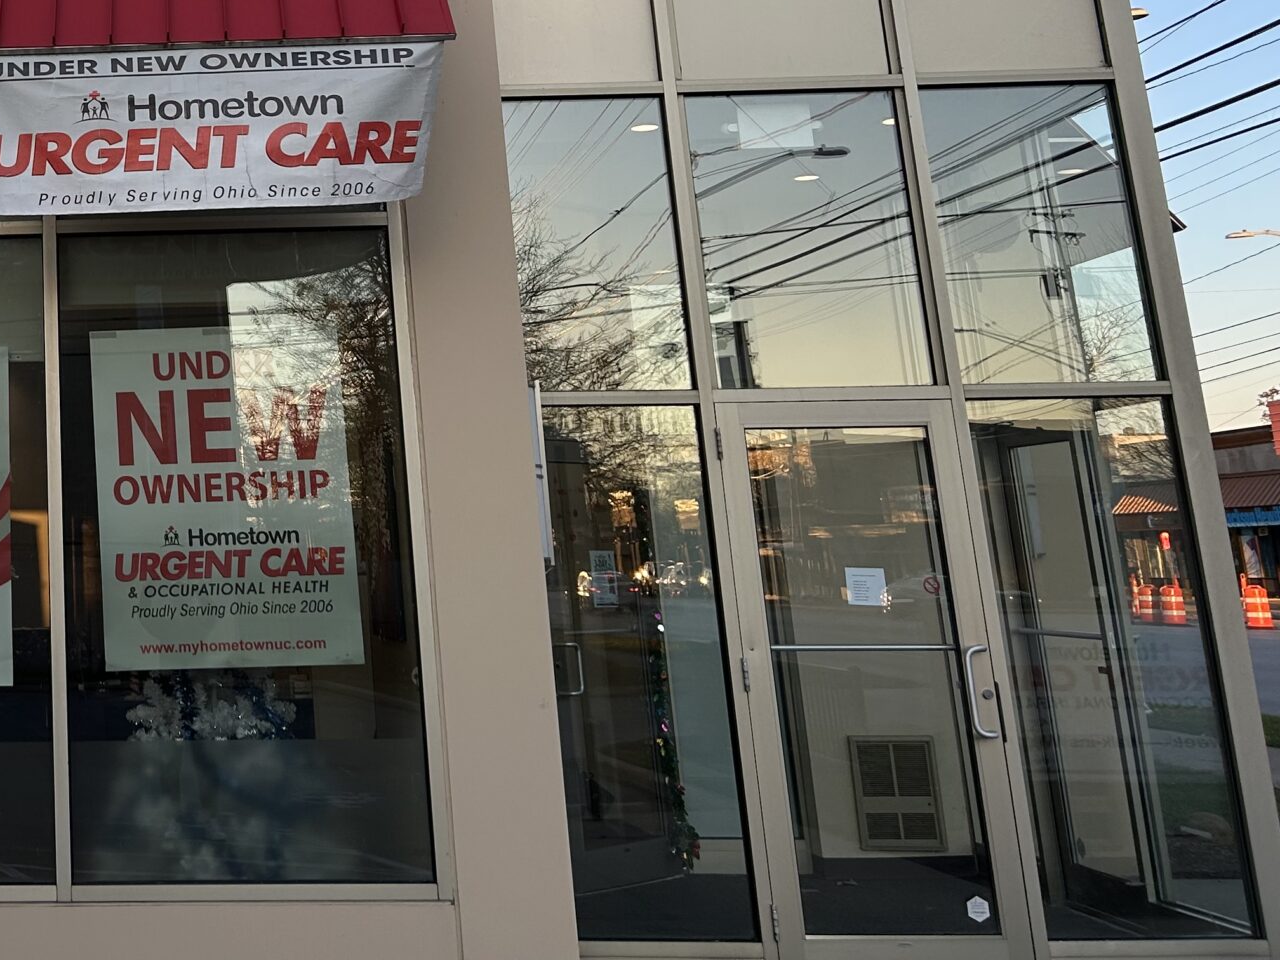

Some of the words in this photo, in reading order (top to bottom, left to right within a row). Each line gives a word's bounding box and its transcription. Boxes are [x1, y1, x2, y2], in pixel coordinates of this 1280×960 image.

[110, 54, 188, 75] NEW
[199, 46, 415, 72] OWNERSHIP
[127, 90, 345, 122] Hometown
[265, 120, 423, 168] CARE
[38, 186, 117, 207] Proudly
[125, 186, 203, 204] Serving
[212, 185, 259, 200] Ohio
[266, 182, 322, 198] Since
[329, 180, 376, 198] 2006
[115, 382, 328, 467] NEW
[113, 469, 331, 507] OWNERSHIP
[187, 526, 300, 547] Hometown
[114, 547, 252, 583] URGENT
[259, 546, 346, 578] CARE
[127, 586, 138, 599] &
[143, 582, 266, 599] OCCUPATIONAL
[271, 580, 329, 595] HEALTH
[131, 604, 178, 620] Proudly
[179, 602, 226, 619] Serving
[229, 601, 259, 616] Ohio
[261, 600, 296, 615] Since
[299, 599, 334, 614] 2006
[139, 638, 327, 656] www.myhometownuc.com
